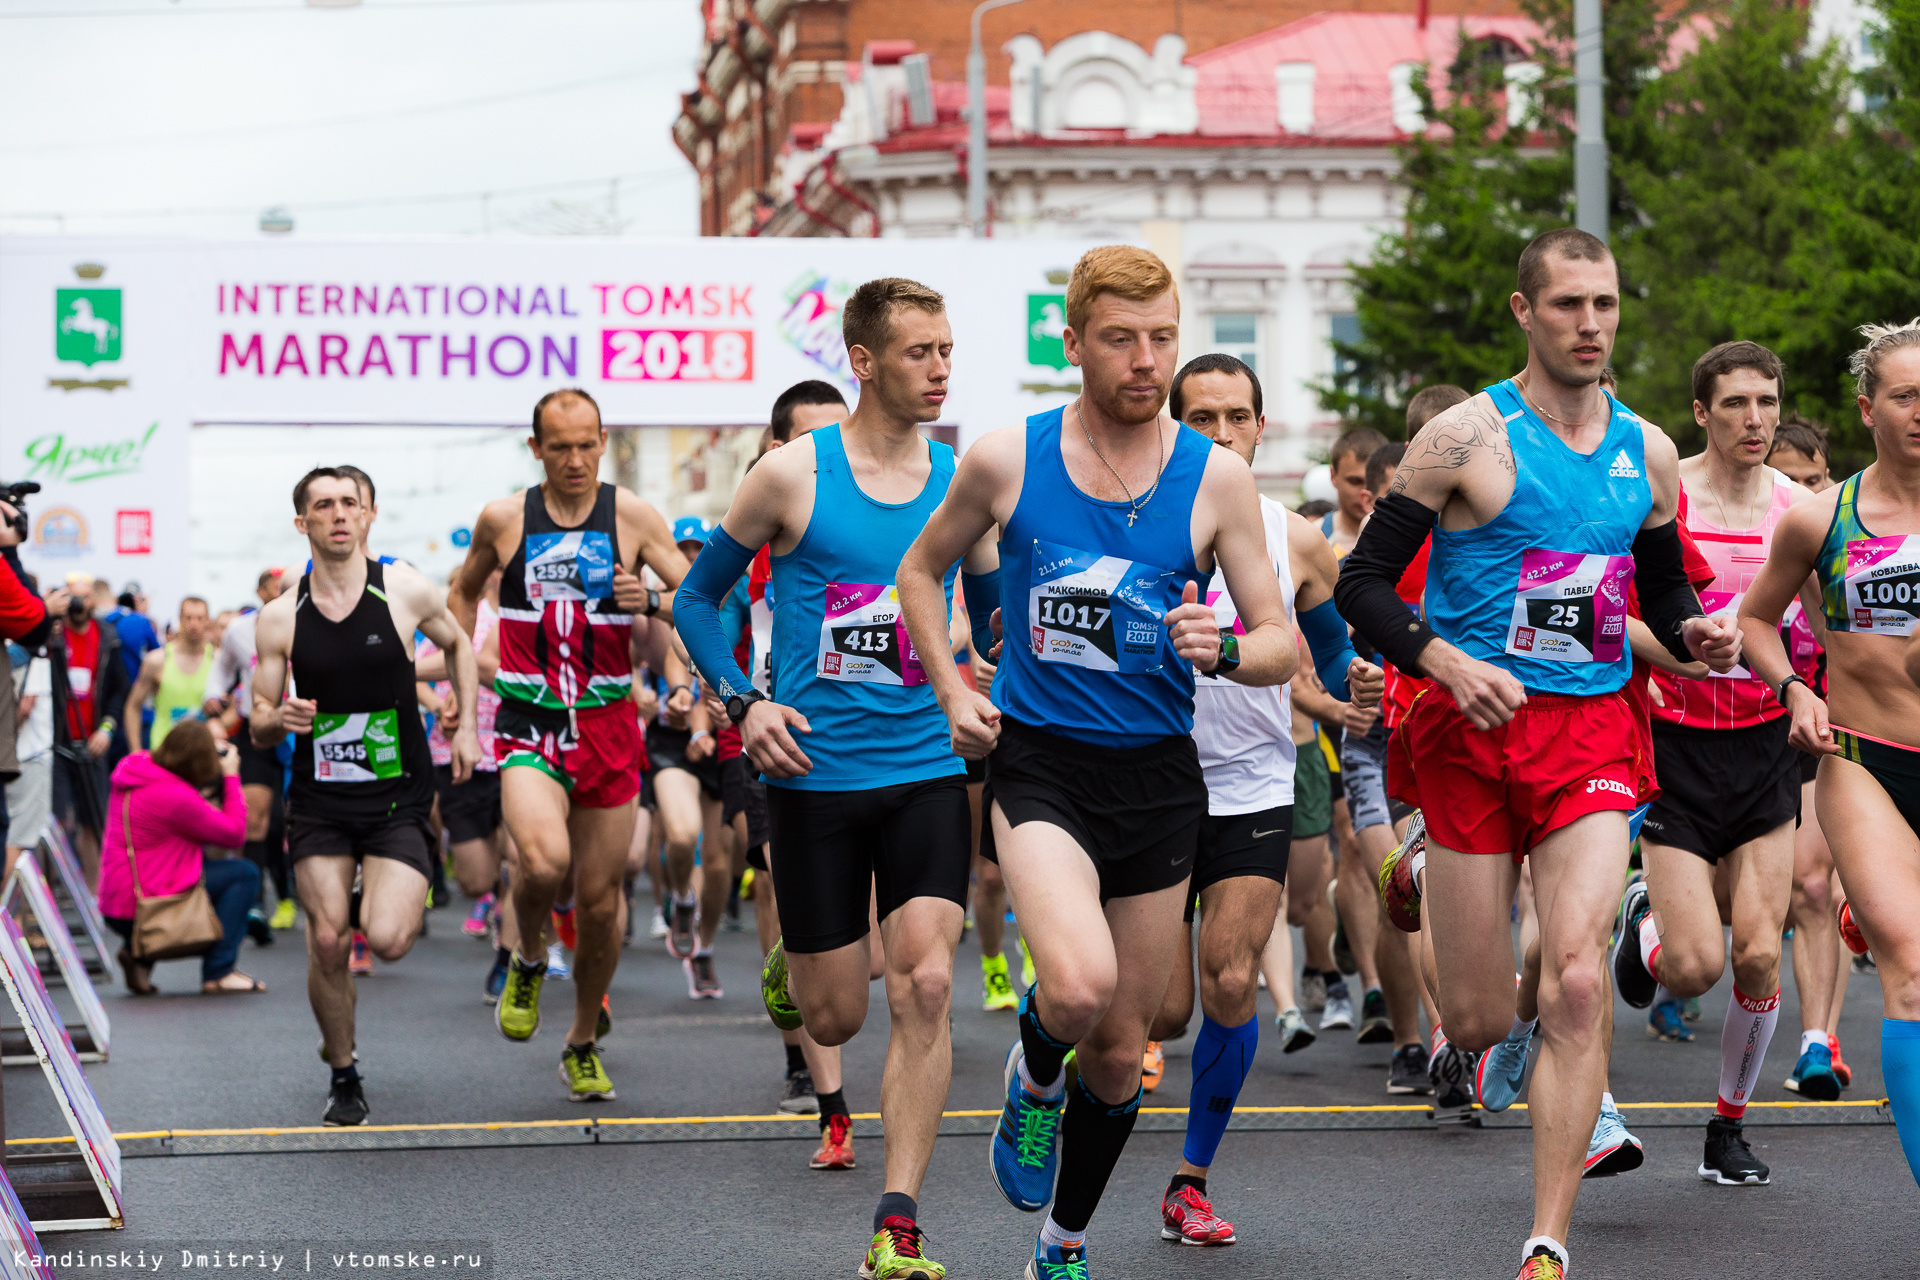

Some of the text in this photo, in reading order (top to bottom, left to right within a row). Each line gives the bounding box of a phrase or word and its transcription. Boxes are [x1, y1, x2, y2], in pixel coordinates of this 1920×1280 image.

[217, 284, 754, 317] INTERNATIONAL TOMSK
[219, 333, 578, 378] MARATHON
[608, 331, 748, 380] 2018
[1608, 467, 1640, 479] adidas
[1853, 552, 1872, 569] 42,2
[536, 563, 580, 581] 2597
[1038, 562, 1057, 577] 21,1
[1526, 565, 1549, 582] 42,2
[1047, 585, 1107, 597] МАКСИМОВ
[1564, 585, 1593, 596] ПАВЕЛ
[831, 596, 850, 611] 42,2
[872, 613, 895, 623] ЕГОР
[1041, 599, 1112, 631] 1017
[1546, 604, 1580, 628] 25
[1126, 620, 1159, 631] TOMSK
[844, 629, 890, 652] 413
[1128, 631, 1155, 643] 2018
[1052, 646, 1082, 656] go-run.club
[1071, 641, 1086, 650] run
[1736, 1015, 1763, 1089] COMPRESSPORT
